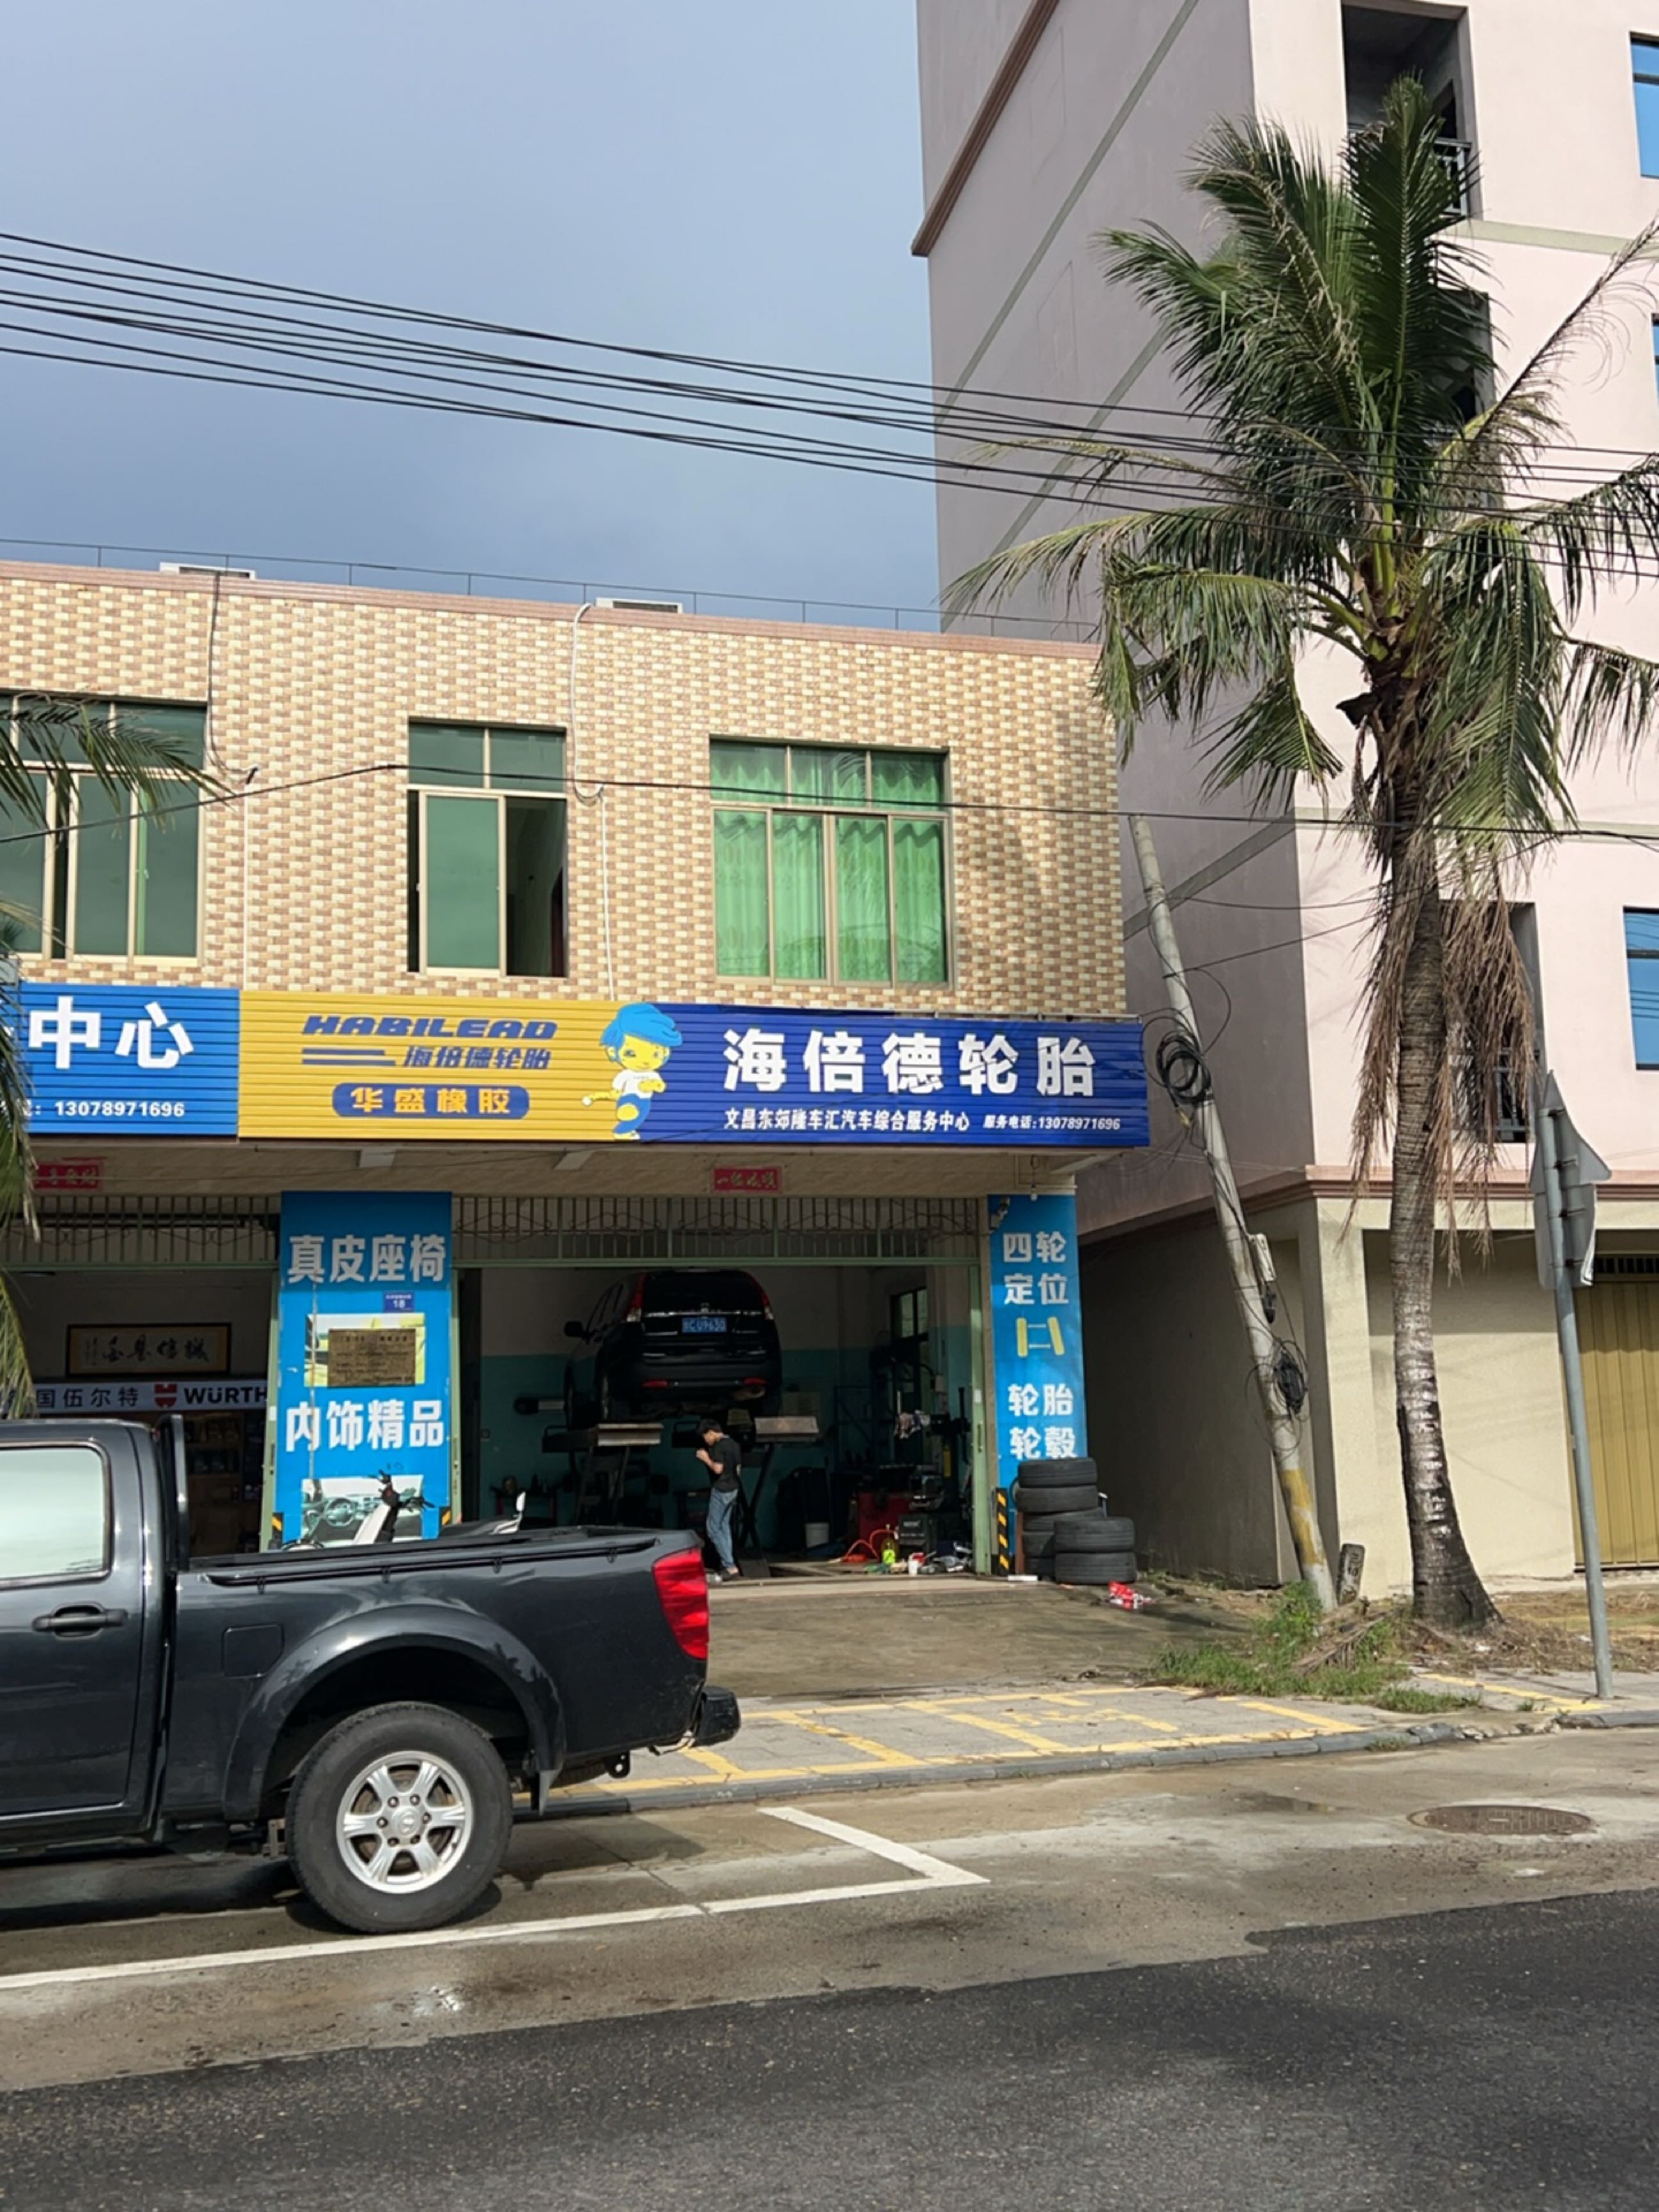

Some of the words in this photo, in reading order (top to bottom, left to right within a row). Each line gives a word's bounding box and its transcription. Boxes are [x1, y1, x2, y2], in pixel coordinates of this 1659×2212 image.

[0, 996, 194, 1070] 中心
[302, 1015, 558, 1039] HABILEAD
[403, 1045, 552, 1070] 海倍德轮胎
[723, 1028, 1096, 1096] 海倍德轮胎
[54, 1101, 186, 1117] 13078971696
[350, 1087, 511, 1114] 华盛橡胶
[287, 1234, 447, 1283] 真皮座椅
[1003, 1231, 1066, 1263] 四轮
[1004, 1273, 1069, 1304] 定位
[9, 1386, 139, 1408] 国伍尔特
[1008, 1383, 1074, 1416] 轮胎
[285, 1399, 444, 1452] 内饰精品
